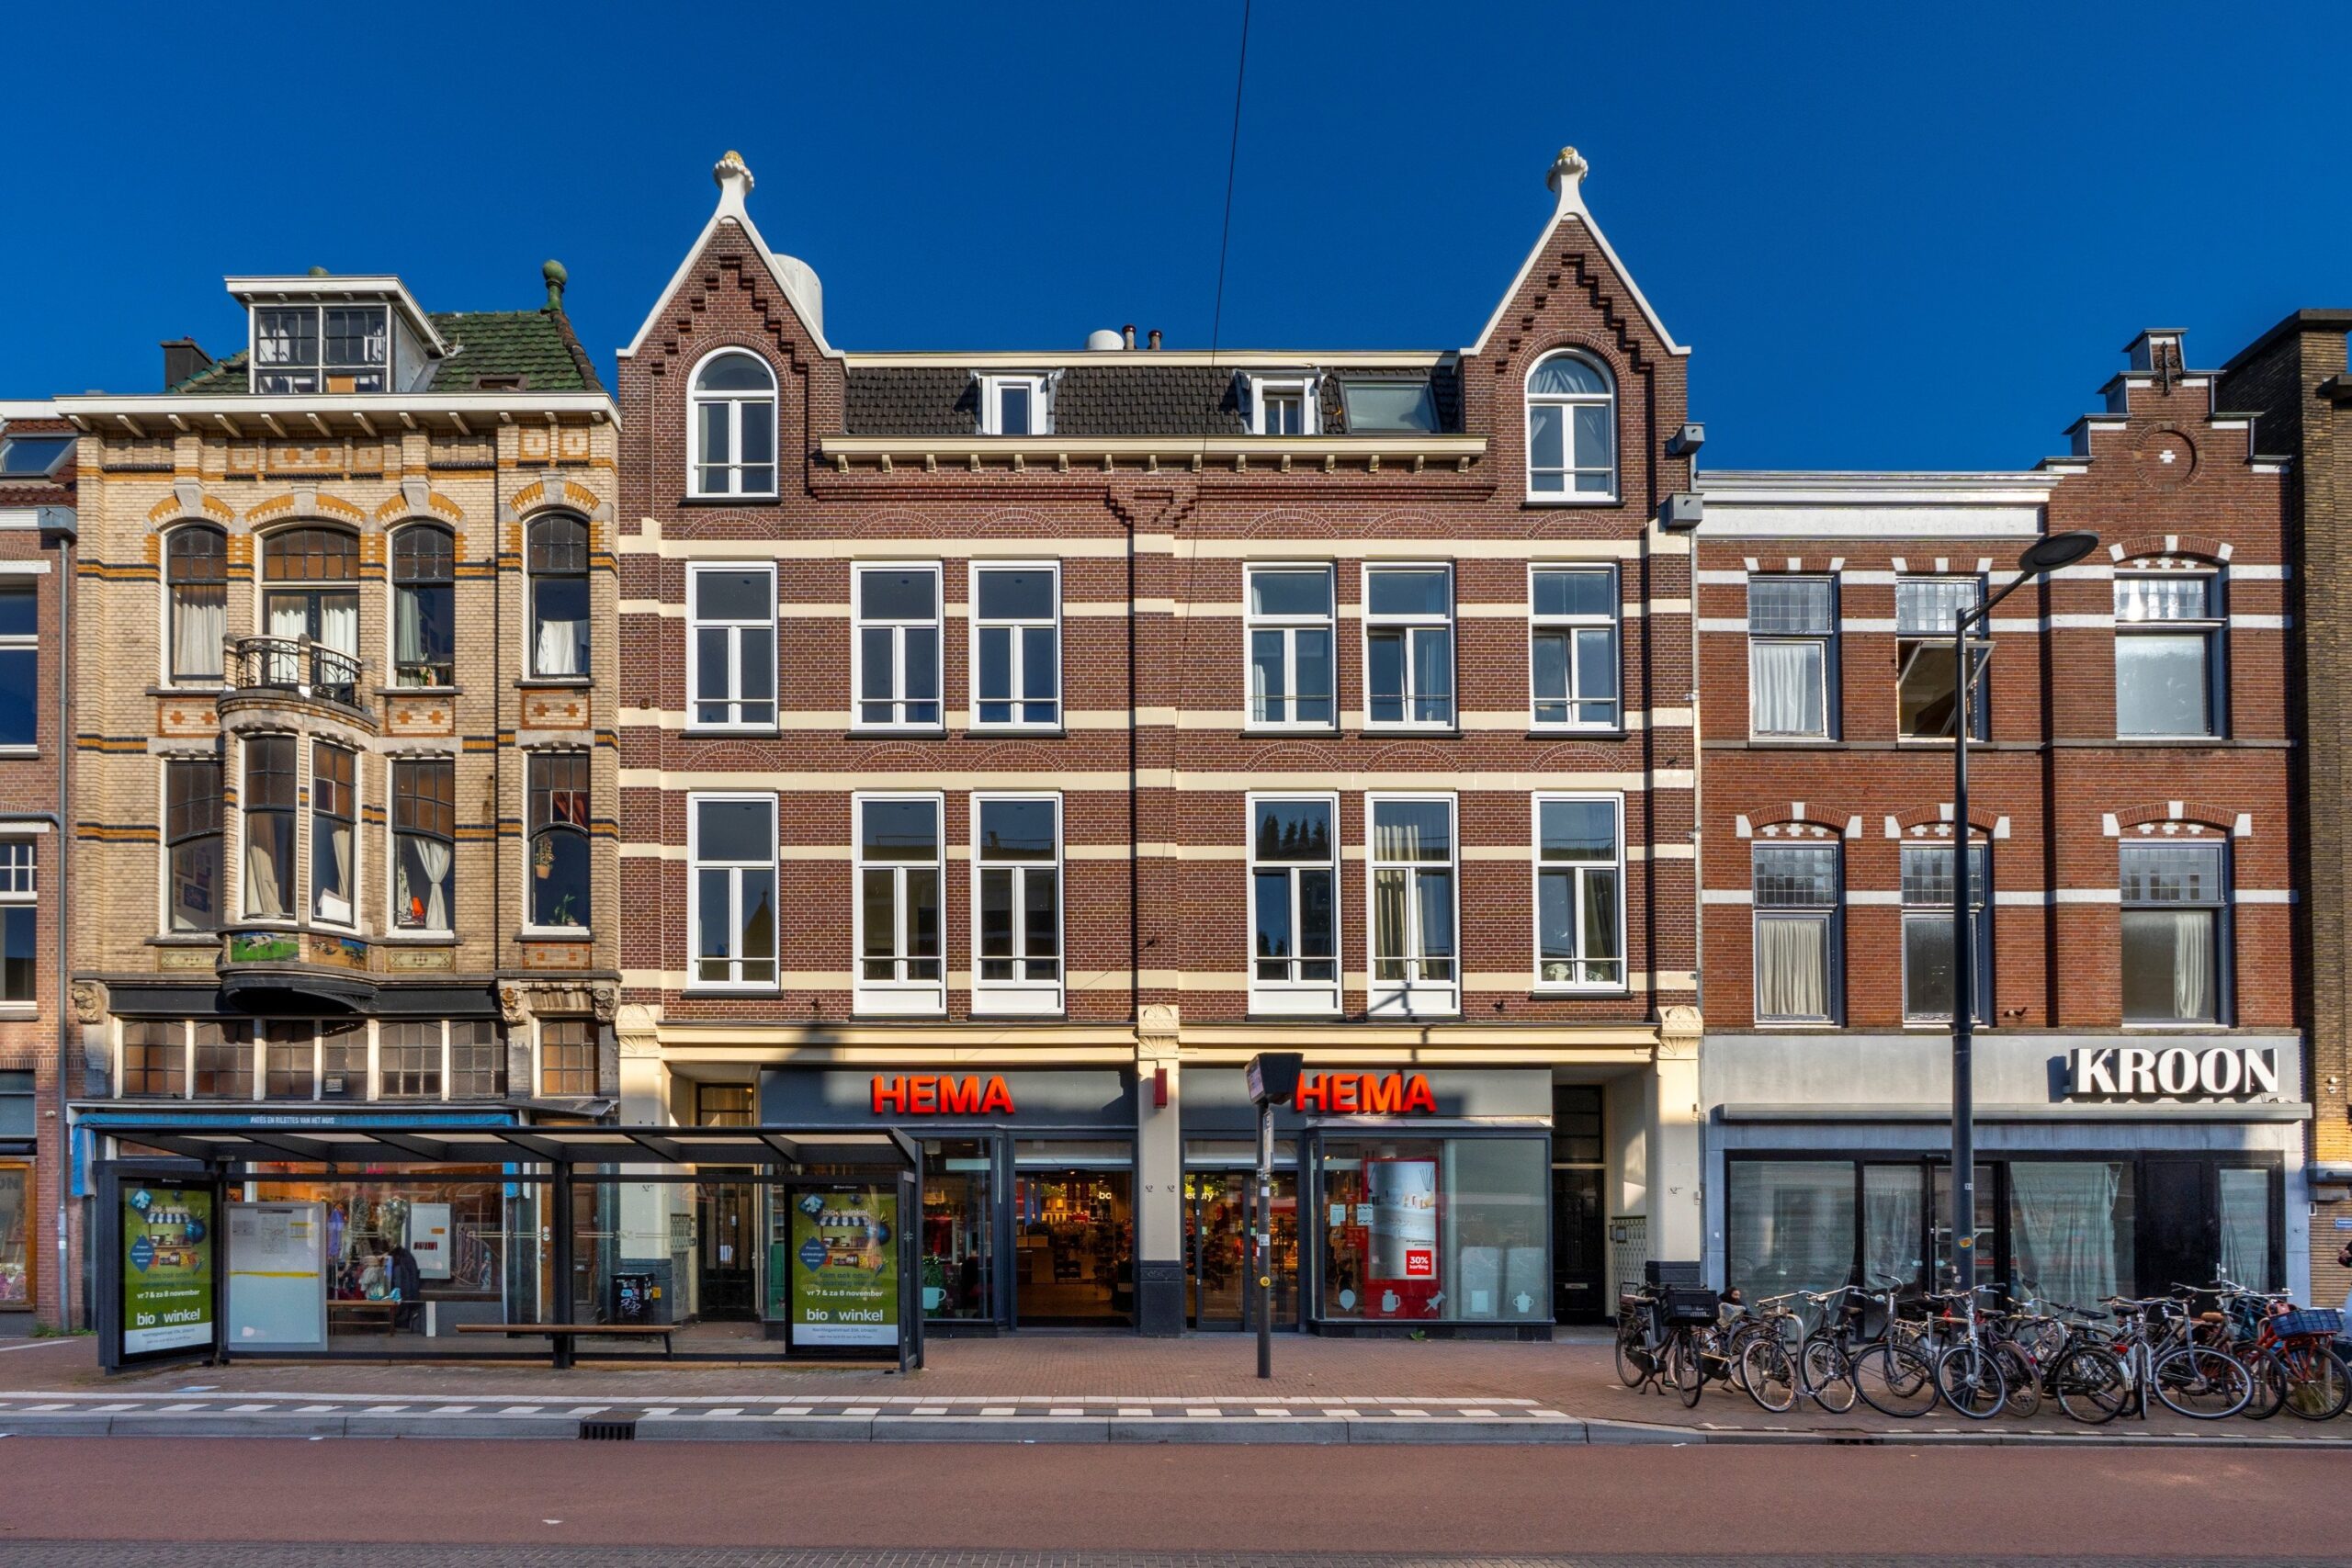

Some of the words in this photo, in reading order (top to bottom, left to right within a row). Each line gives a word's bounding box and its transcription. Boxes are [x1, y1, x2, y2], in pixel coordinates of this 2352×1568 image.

[2073, 1048, 2278, 1094] KROON
[872, 1075, 1015, 1114] HEMA
[1295, 1072, 1438, 1113] HEMA
[267, 1116, 275, 1124] EN
[276, 1116, 300, 1124] RILETTES
[300, 1116, 311, 1124] VAN
[311, 1116, 321, 1124] HET
[322, 1116, 334, 1124] HUIS
[1409, 1256, 1429, 1264] 30%
[169, 1289, 200, 1297] november
[137, 1313, 155, 1325] bio
[164, 1308, 201, 1323] winkel
[807, 1308, 829, 1321] bio
[838, 1308, 884, 1322] winkel
